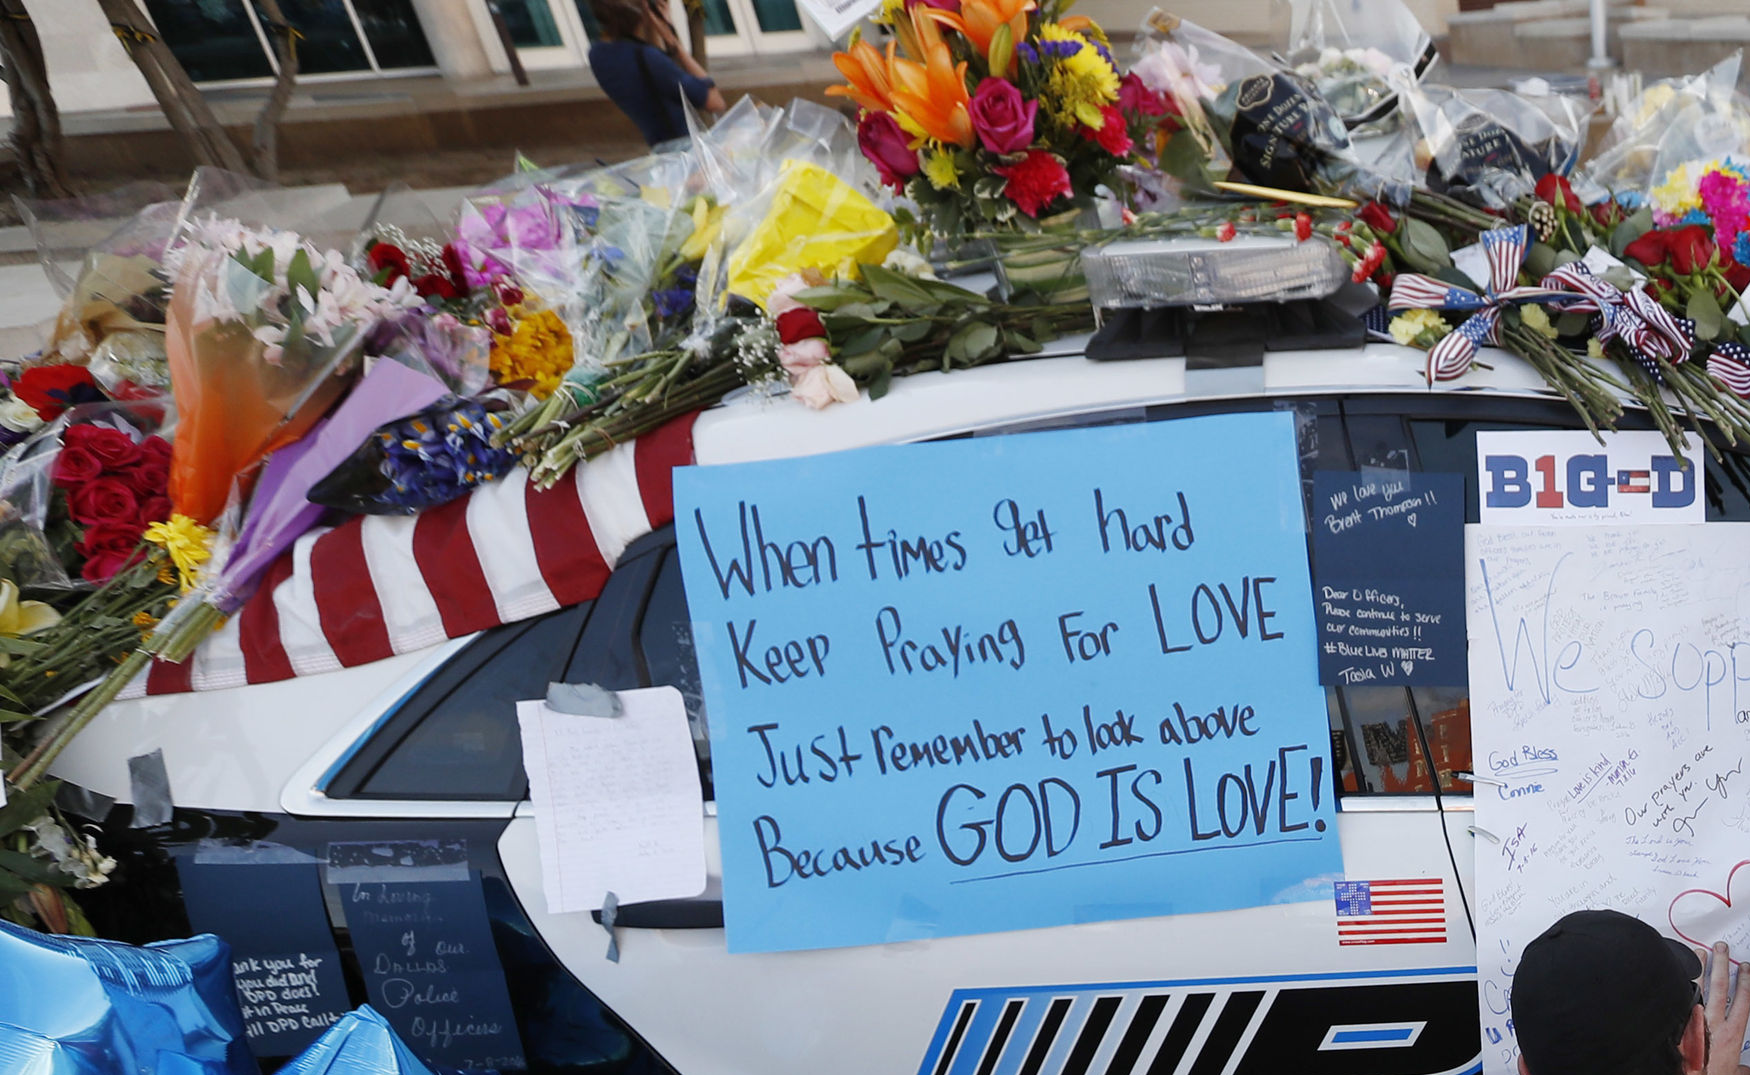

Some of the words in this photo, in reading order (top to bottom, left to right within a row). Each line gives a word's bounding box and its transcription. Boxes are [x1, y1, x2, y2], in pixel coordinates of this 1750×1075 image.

[1330, 492, 1348, 511] We
[1353, 484, 1376, 501] love
[694, 502, 838, 600] When
[857, 495, 968, 582] times
[993, 498, 1058, 560] get
[1094, 487, 1195, 554] hard
[1322, 585, 1349, 601] Dear
[1326, 622, 1346, 633] our
[1400, 611, 1410, 622] to
[1415, 611, 1442, 624] serve
[1479, 552, 1600, 704] We
[726, 619, 832, 690] Keep
[876, 605, 1027, 681] Praying
[1058, 611, 1119, 663] For
[1149, 576, 1285, 655] LOVE
[748, 722, 864, 790] Just
[1042, 714, 1077, 762] to
[1082, 705, 1144, 754] look
[1160, 701, 1260, 746] above
[1489, 750, 1518, 771] God
[1522, 745, 1558, 762] Bless
[1498, 780, 1545, 800] Connie
[1651, 763, 1691, 807] prayers
[752, 814, 925, 888] Because
[936, 782, 1080, 865] GOD
[1096, 763, 1163, 850] IS
[1184, 745, 1327, 842] LOVE!
[263, 959, 295, 975] you
[382, 977, 459, 1009] Police
[265, 1018, 299, 1033] DPD
